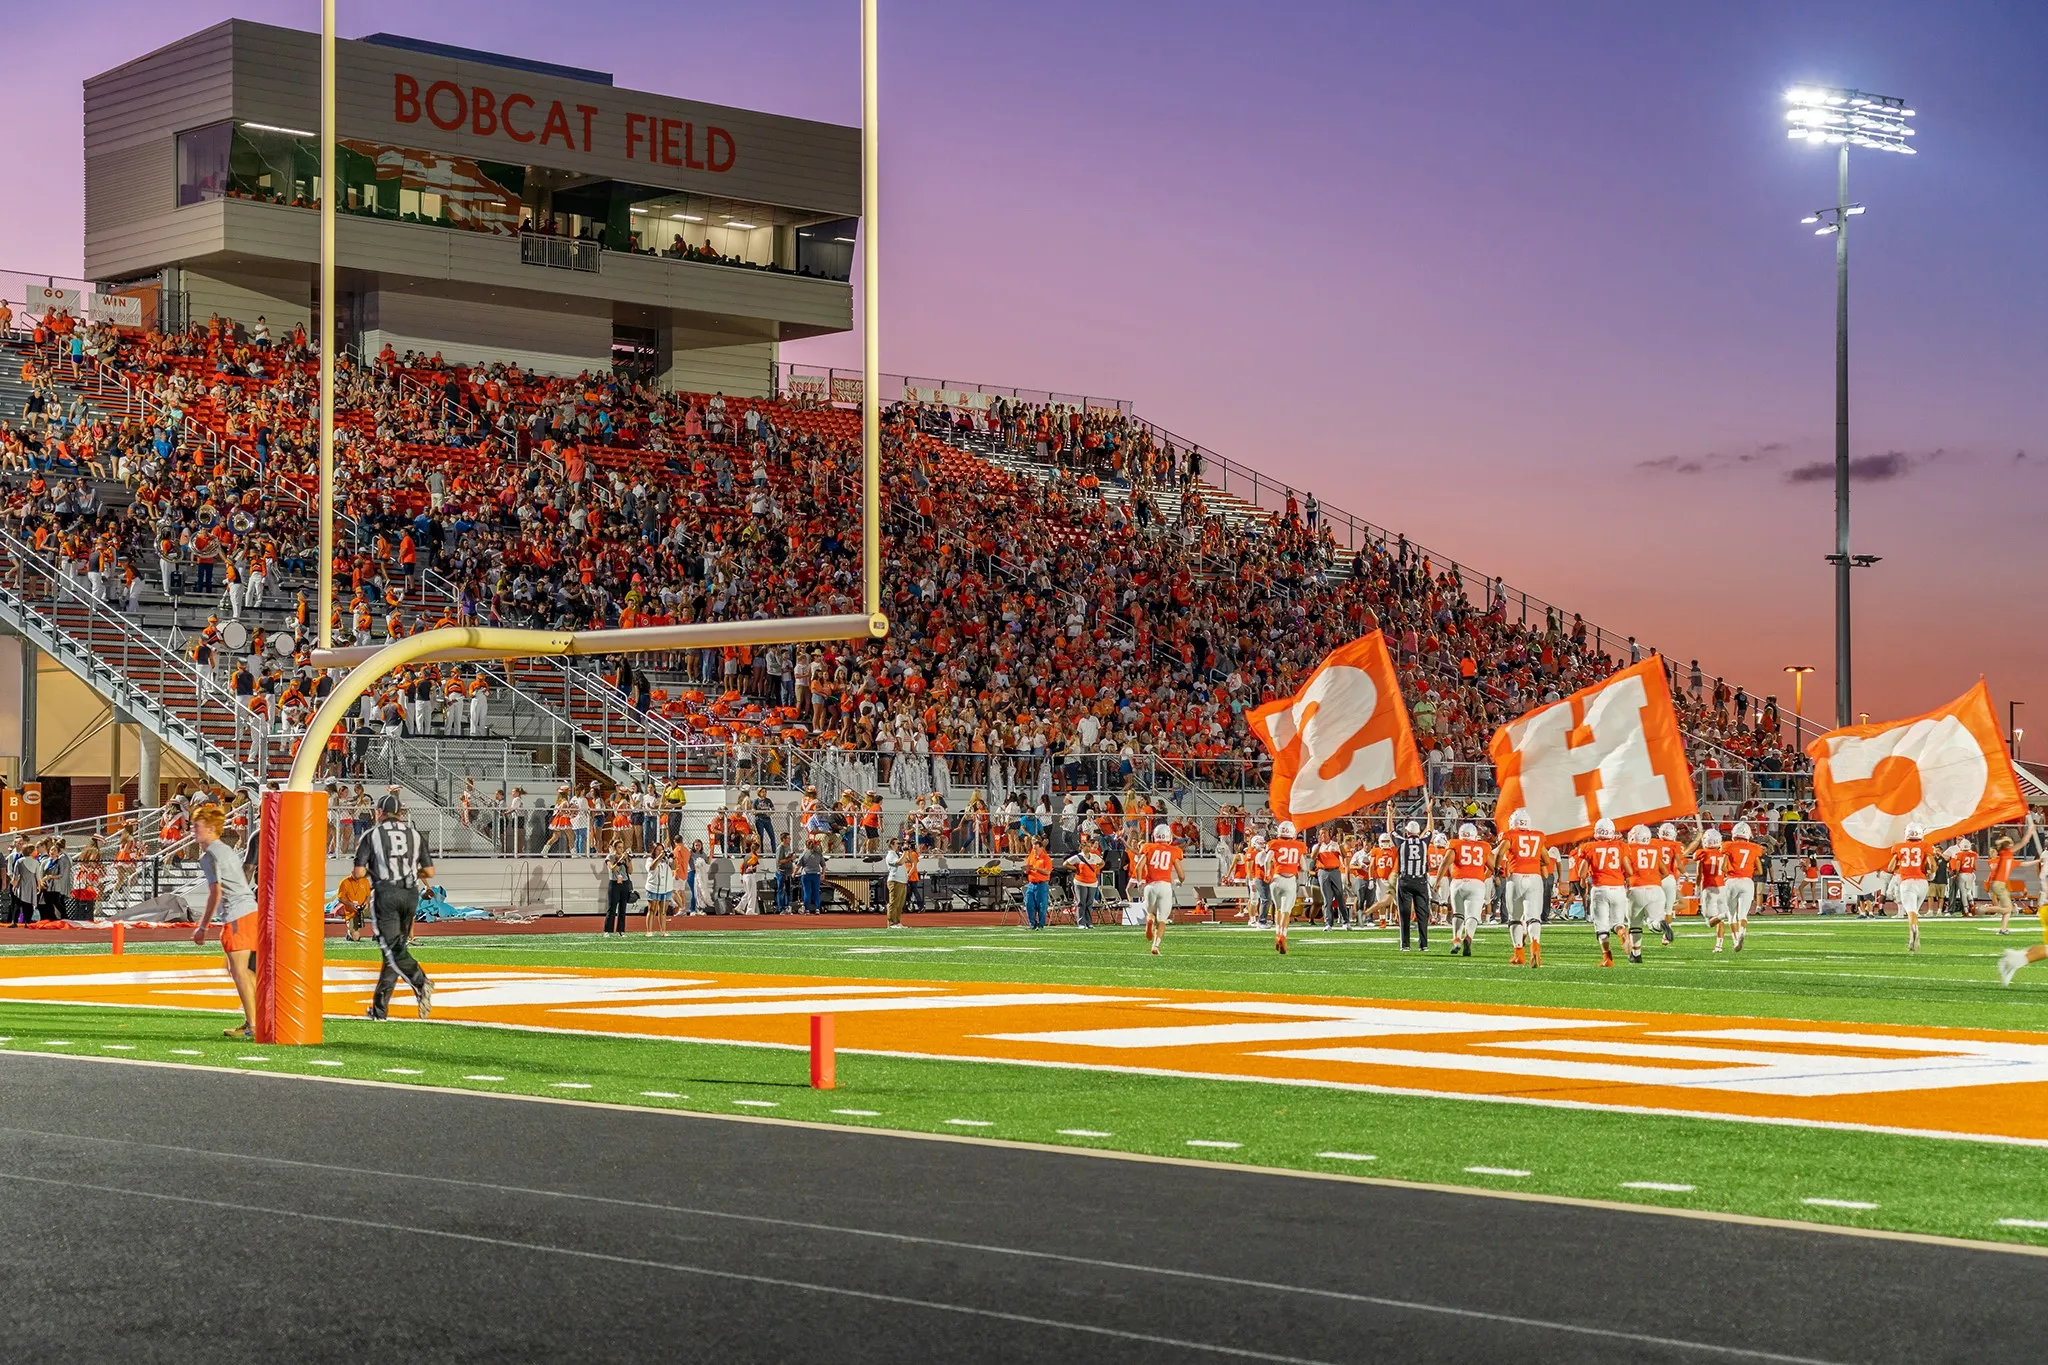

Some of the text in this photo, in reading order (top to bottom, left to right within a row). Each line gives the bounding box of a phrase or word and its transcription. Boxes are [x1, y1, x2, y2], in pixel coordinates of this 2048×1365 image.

[394, 73, 736, 173] BOBCAT FIELD
[43, 288, 64, 299] GO
[103, 296, 127, 307] WIN
[1505, 675, 1672, 835] H
[388, 831, 408, 856] B
[1408, 845, 1421, 860] R
[1518, 835, 1541, 858] 57
[1150, 849, 1172, 871] 40
[1277, 847, 1299, 865] 20
[1461, 845, 1484, 866] 53
[1595, 847, 1620, 870] 73
[1637, 848, 1658, 870] 67
[1660, 846, 1671, 865] 5
[1709, 855, 1724, 876] 11
[1739, 849, 1750, 869] 7
[1900, 847, 1922, 867] 33
[1963, 856, 1975, 869] 21
